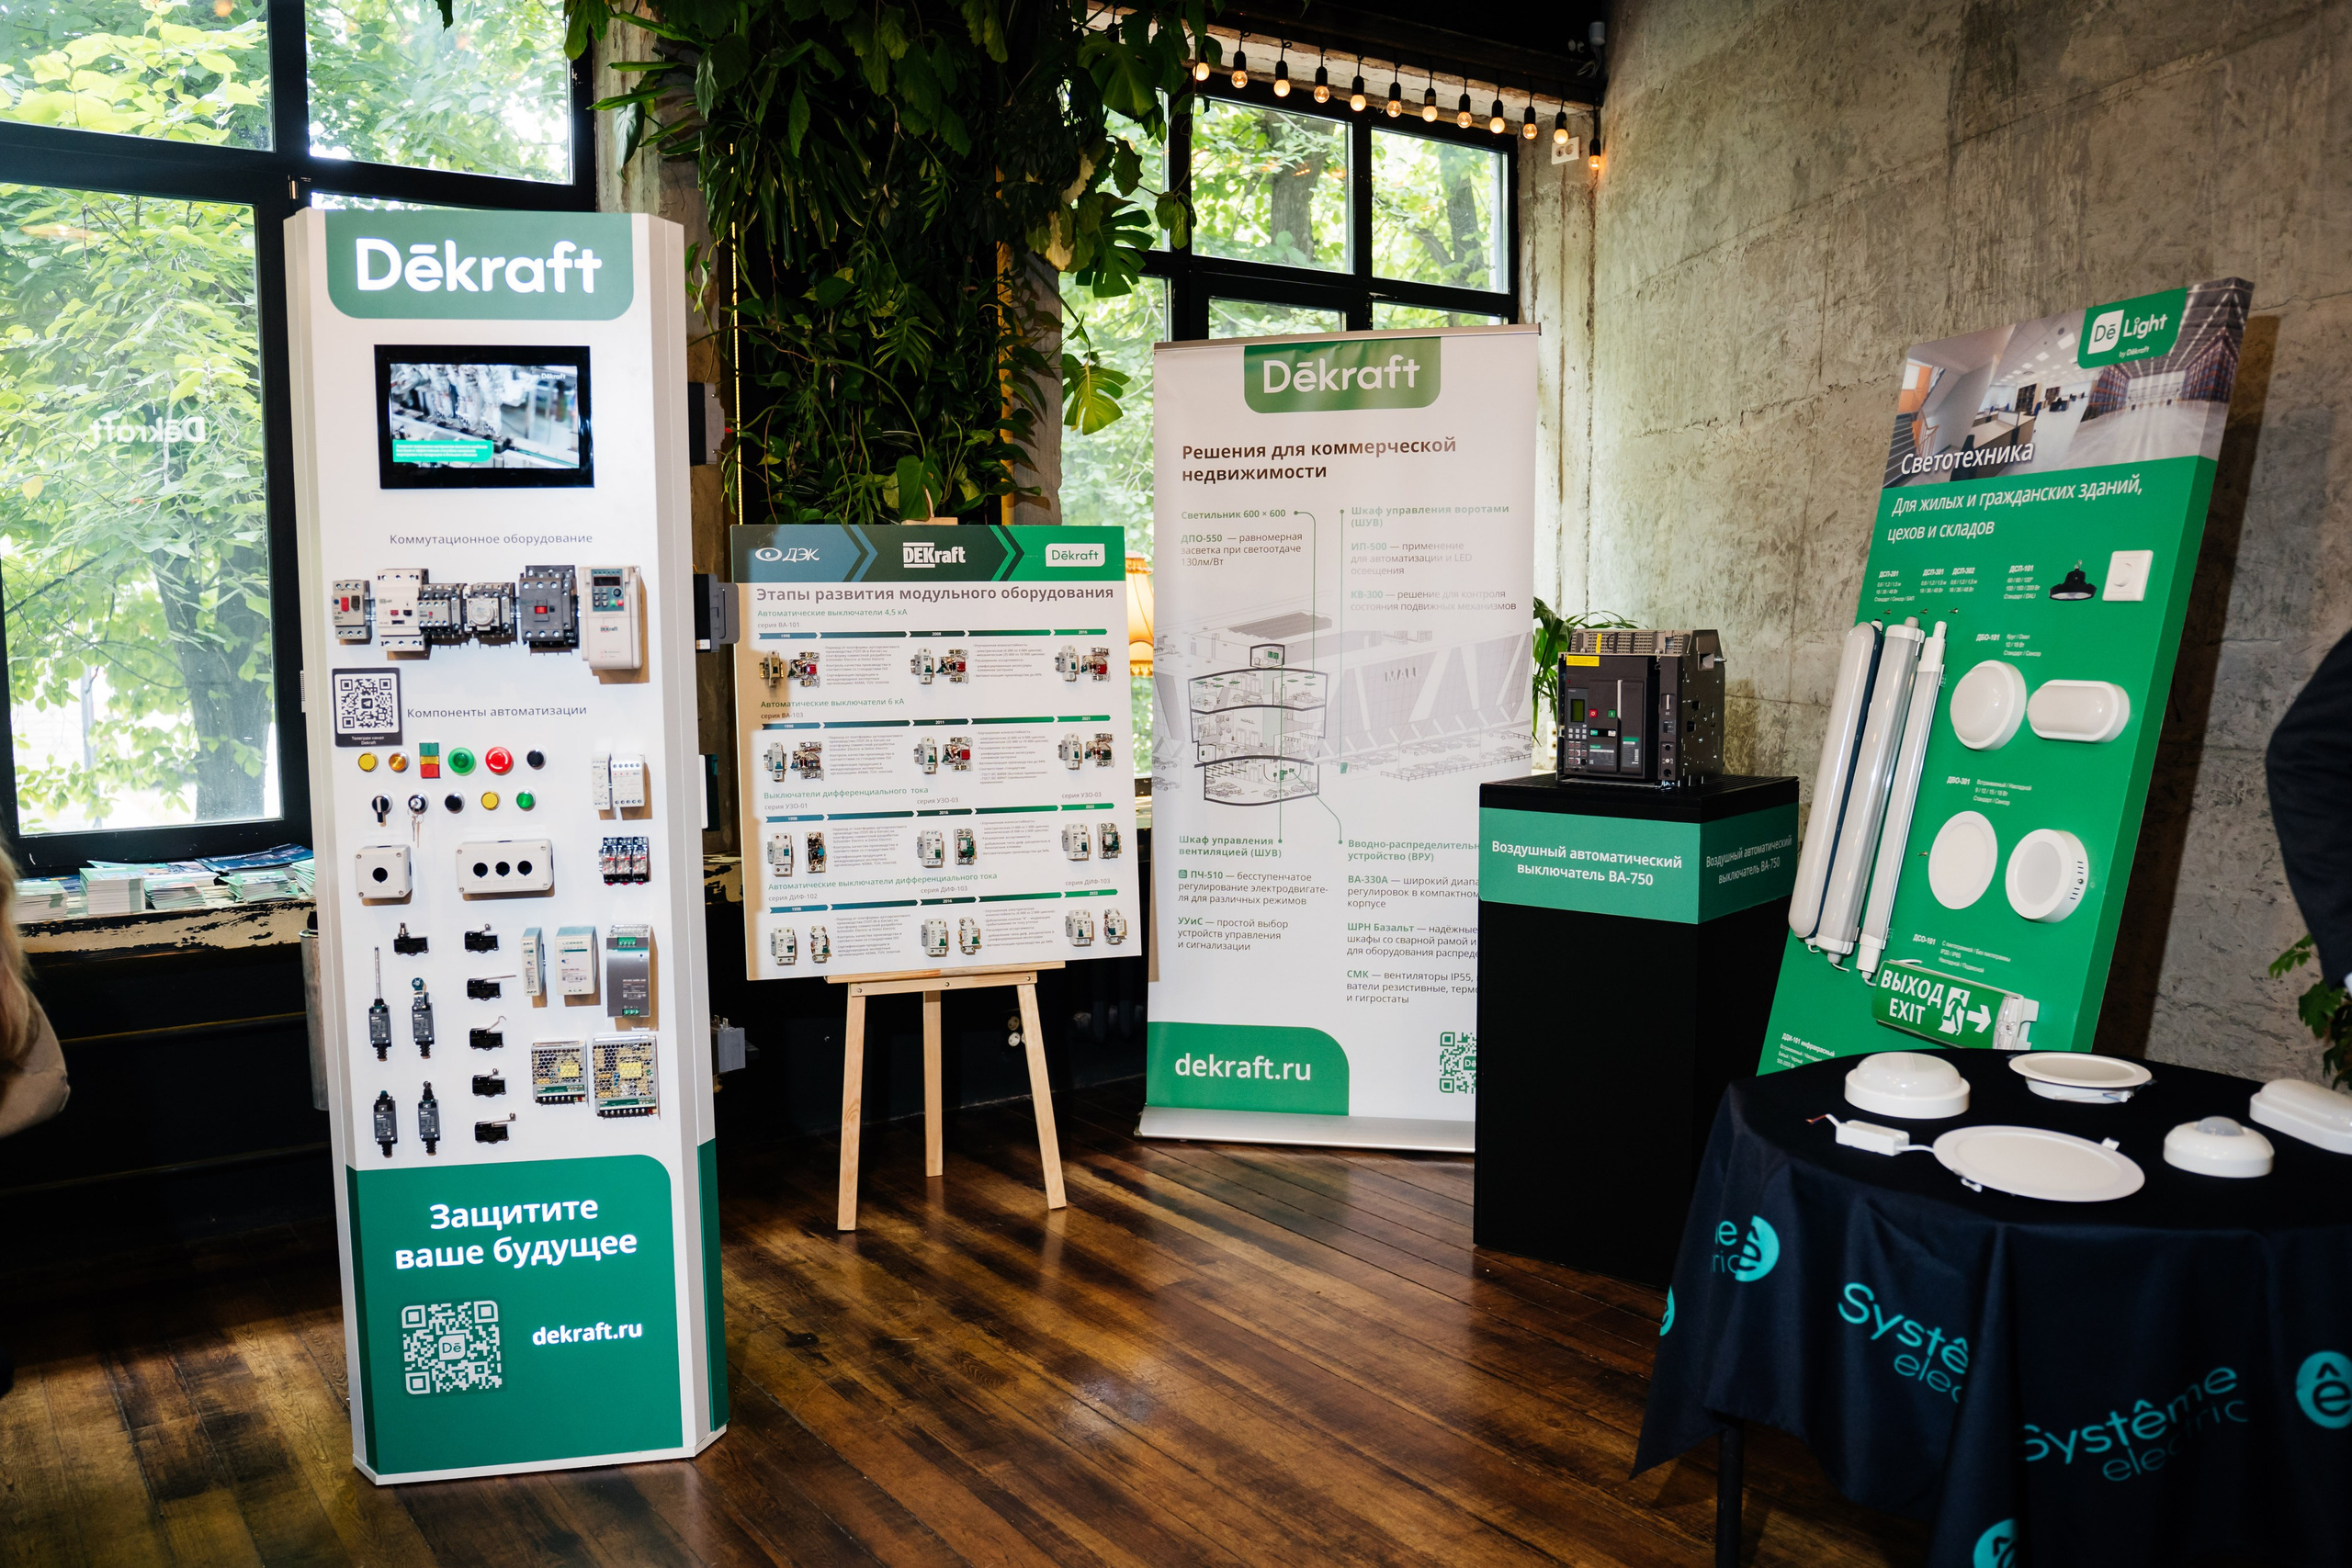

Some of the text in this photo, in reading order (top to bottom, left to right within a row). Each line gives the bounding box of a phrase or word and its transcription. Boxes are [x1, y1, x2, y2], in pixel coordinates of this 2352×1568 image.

[355, 237, 603, 294] Dēkraft
[2122, 314, 2168, 339] Light
[1262, 354, 1420, 394] Dēkraft
[1182, 436, 1456, 461] Решения для коммерческой
[1900, 442, 2035, 475] Светотехника
[1182, 465, 1328, 485] недвижимости
[1891, 473, 2143, 517] Для жилых и гражданских зданий,
[1181, 509, 1286, 520] Светильник 600 600
[1351, 505, 1510, 517] Шкаф управления воротами
[1351, 518, 1384, 528] (ШУВ)
[1181, 533, 1303, 544] ДПО-550 равномерная
[1887, 521, 1996, 544] цехов и складов
[390, 532, 594, 547] Коммутационное оборудование
[1181, 545, 1302, 556] засветка при светоотдаче
[1351, 541, 1464, 552] ИП-500 применение
[783, 547, 820, 563] ДЭК
[902, 544, 967, 566] DEKraft
[1051, 548, 1099, 560] Dēkraft
[1351, 553, 1473, 564] для автоматизации и LED
[1182, 558, 1224, 567] 130лм/Вт
[1351, 567, 1405, 576] освещения
[756, 586, 1114, 604] Этапы развития модульного оборудования
[1351, 590, 1506, 601] КВ-300 решение для контроля
[757, 609, 826, 617] Автоматические
[884, 608, 897, 616] 4,5
[1351, 602, 1517, 613] состояния подвижных механизмов
[761, 699, 830, 708] Автоматические
[831, 698, 888, 706] выключатели
[894, 697, 905, 705] кА
[406, 705, 588, 719] Компоненты автоматизации
[763, 790, 821, 799] Выключатели
[822, 787, 908, 798] дифференциального
[1179, 835, 1274, 847] Шкаф управления
[1179, 847, 1283, 859] вентиляцией (ШУВ)
[1491, 840, 1683, 870] Воздушный автоматический
[1706, 834, 1792, 868] Воздушный автоматический
[1348, 852, 1434, 863] устройство (ВРУ)
[1517, 863, 1654, 886] выключатель ВА-750
[1718, 856, 1781, 885] выключатель ВА-750
[768, 881, 837, 890] Автоматические
[838, 878, 894, 886] выключатели
[895, 874, 979, 886] дифференциального
[1191, 871, 1313, 883] ПЧ-510 бесступенчатое
[1348, 874, 1388, 884] ВА-330А
[1403, 876, 1449, 886] широкий
[940, 885, 968, 893] ДИФ-103
[1178, 883, 1249, 892] регулирование
[1347, 887, 1409, 897] регулировок
[788, 893, 818, 902] ДИФ-102
[1191, 895, 1207, 903] для
[1209, 896, 1261, 907] различных
[1262, 897, 1307, 907] режимов
[1347, 901, 1386, 909] корпусе
[1216, 918, 1255, 929] простой
[1257, 919, 1289, 930] выбор
[1347, 922, 1478, 935] ШРН Базальт надёжные
[1177, 929, 1282, 941] устройств управления
[1347, 934, 1380, 944] шкафы
[1395, 936, 1435, 945] сварной
[1437, 937, 1468, 947] рамой
[1185, 942, 1250, 952] сигнализации
[1346, 947, 1363, 955] для
[1365, 947, 1433, 958] оборудования
[1346, 969, 1370, 978] СМК
[1384, 971, 1448, 982] вентиляторы
[1346, 983, 1380, 991] ватели
[1382, 984, 1449, 994] резистивные,
[1880, 969, 1945, 1010] ВЫХОД
[1355, 994, 1409, 1005] гигростаты
[1889, 998, 1927, 1024] EXIT
[1174, 1052, 1312, 1081] dekraft.ru
[429, 1198, 599, 1232] Защитите
[395, 1233, 639, 1270] ваше будущее
[532, 1320, 643, 1346] dekraft.ru
